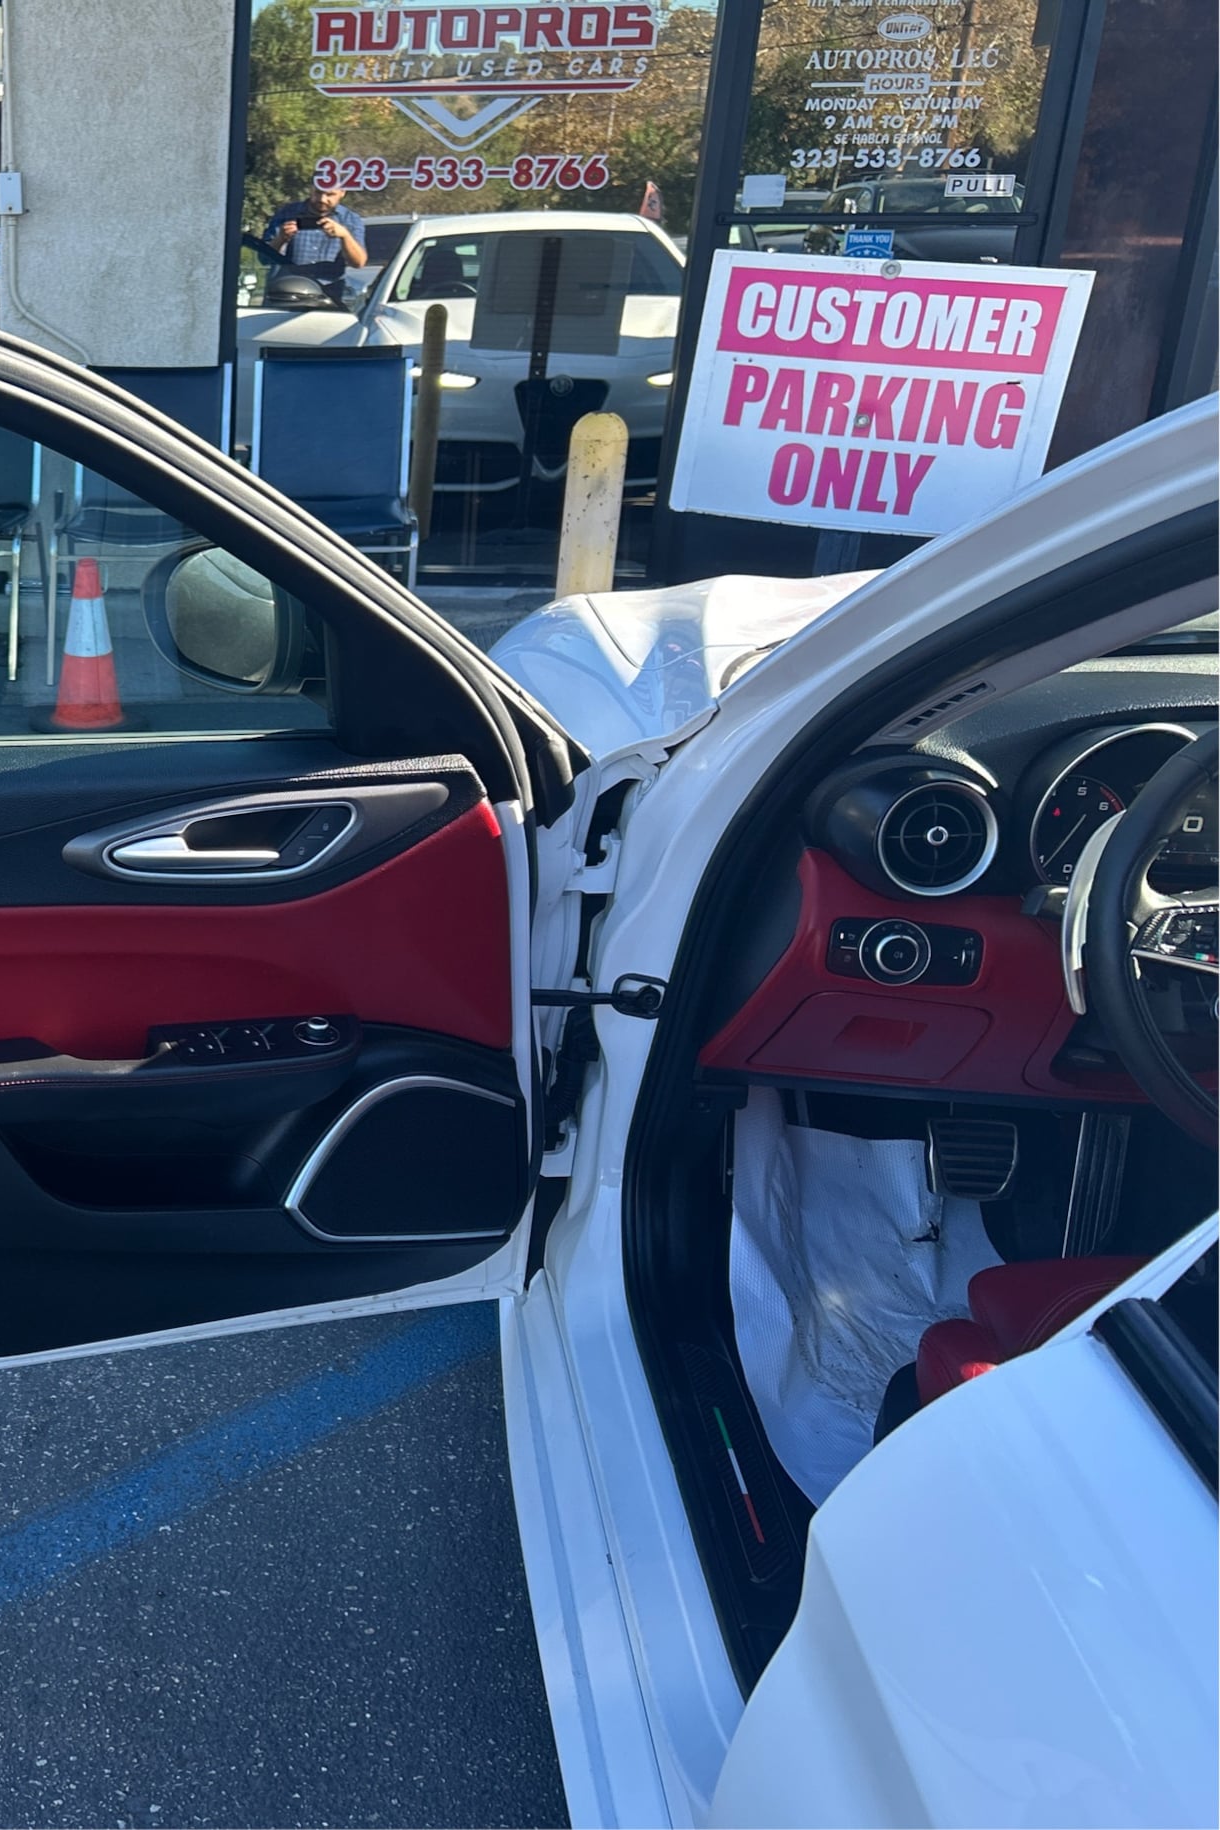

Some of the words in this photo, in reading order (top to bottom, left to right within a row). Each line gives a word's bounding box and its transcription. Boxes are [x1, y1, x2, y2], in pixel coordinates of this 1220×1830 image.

[311, 3, 658, 57] AUTOPROS
[309, 60, 435, 81] QUALITY
[456, 59, 542, 77] USED
[568, 57, 649, 75] CARS
[804, 48, 939, 71] AUTOPROS,
[950, 48, 999, 68] LLC
[868, 77, 925, 92] HOURS
[805, 98, 877, 112] MONDAY
[902, 96, 984, 111] SATURDAY
[823, 115, 836, 130] 9
[842, 114, 873, 129] AM
[879, 114, 904, 129] TO
[914, 114, 926, 128] 7
[930, 114, 958, 129] PM
[833, 133, 849, 145] SE
[851, 133, 890, 145] HABLA
[789, 148, 982, 169] 323-533-8766
[313, 154, 611, 192] 323-533-8766
[951, 178, 1008, 193] PULL
[849, 234, 873, 243] THANK
[875, 234, 891, 243] YOU
[736, 282, 1043, 357] CUSTOMER
[722, 363, 1027, 450] PARKING
[767, 442, 937, 516] ONLY
